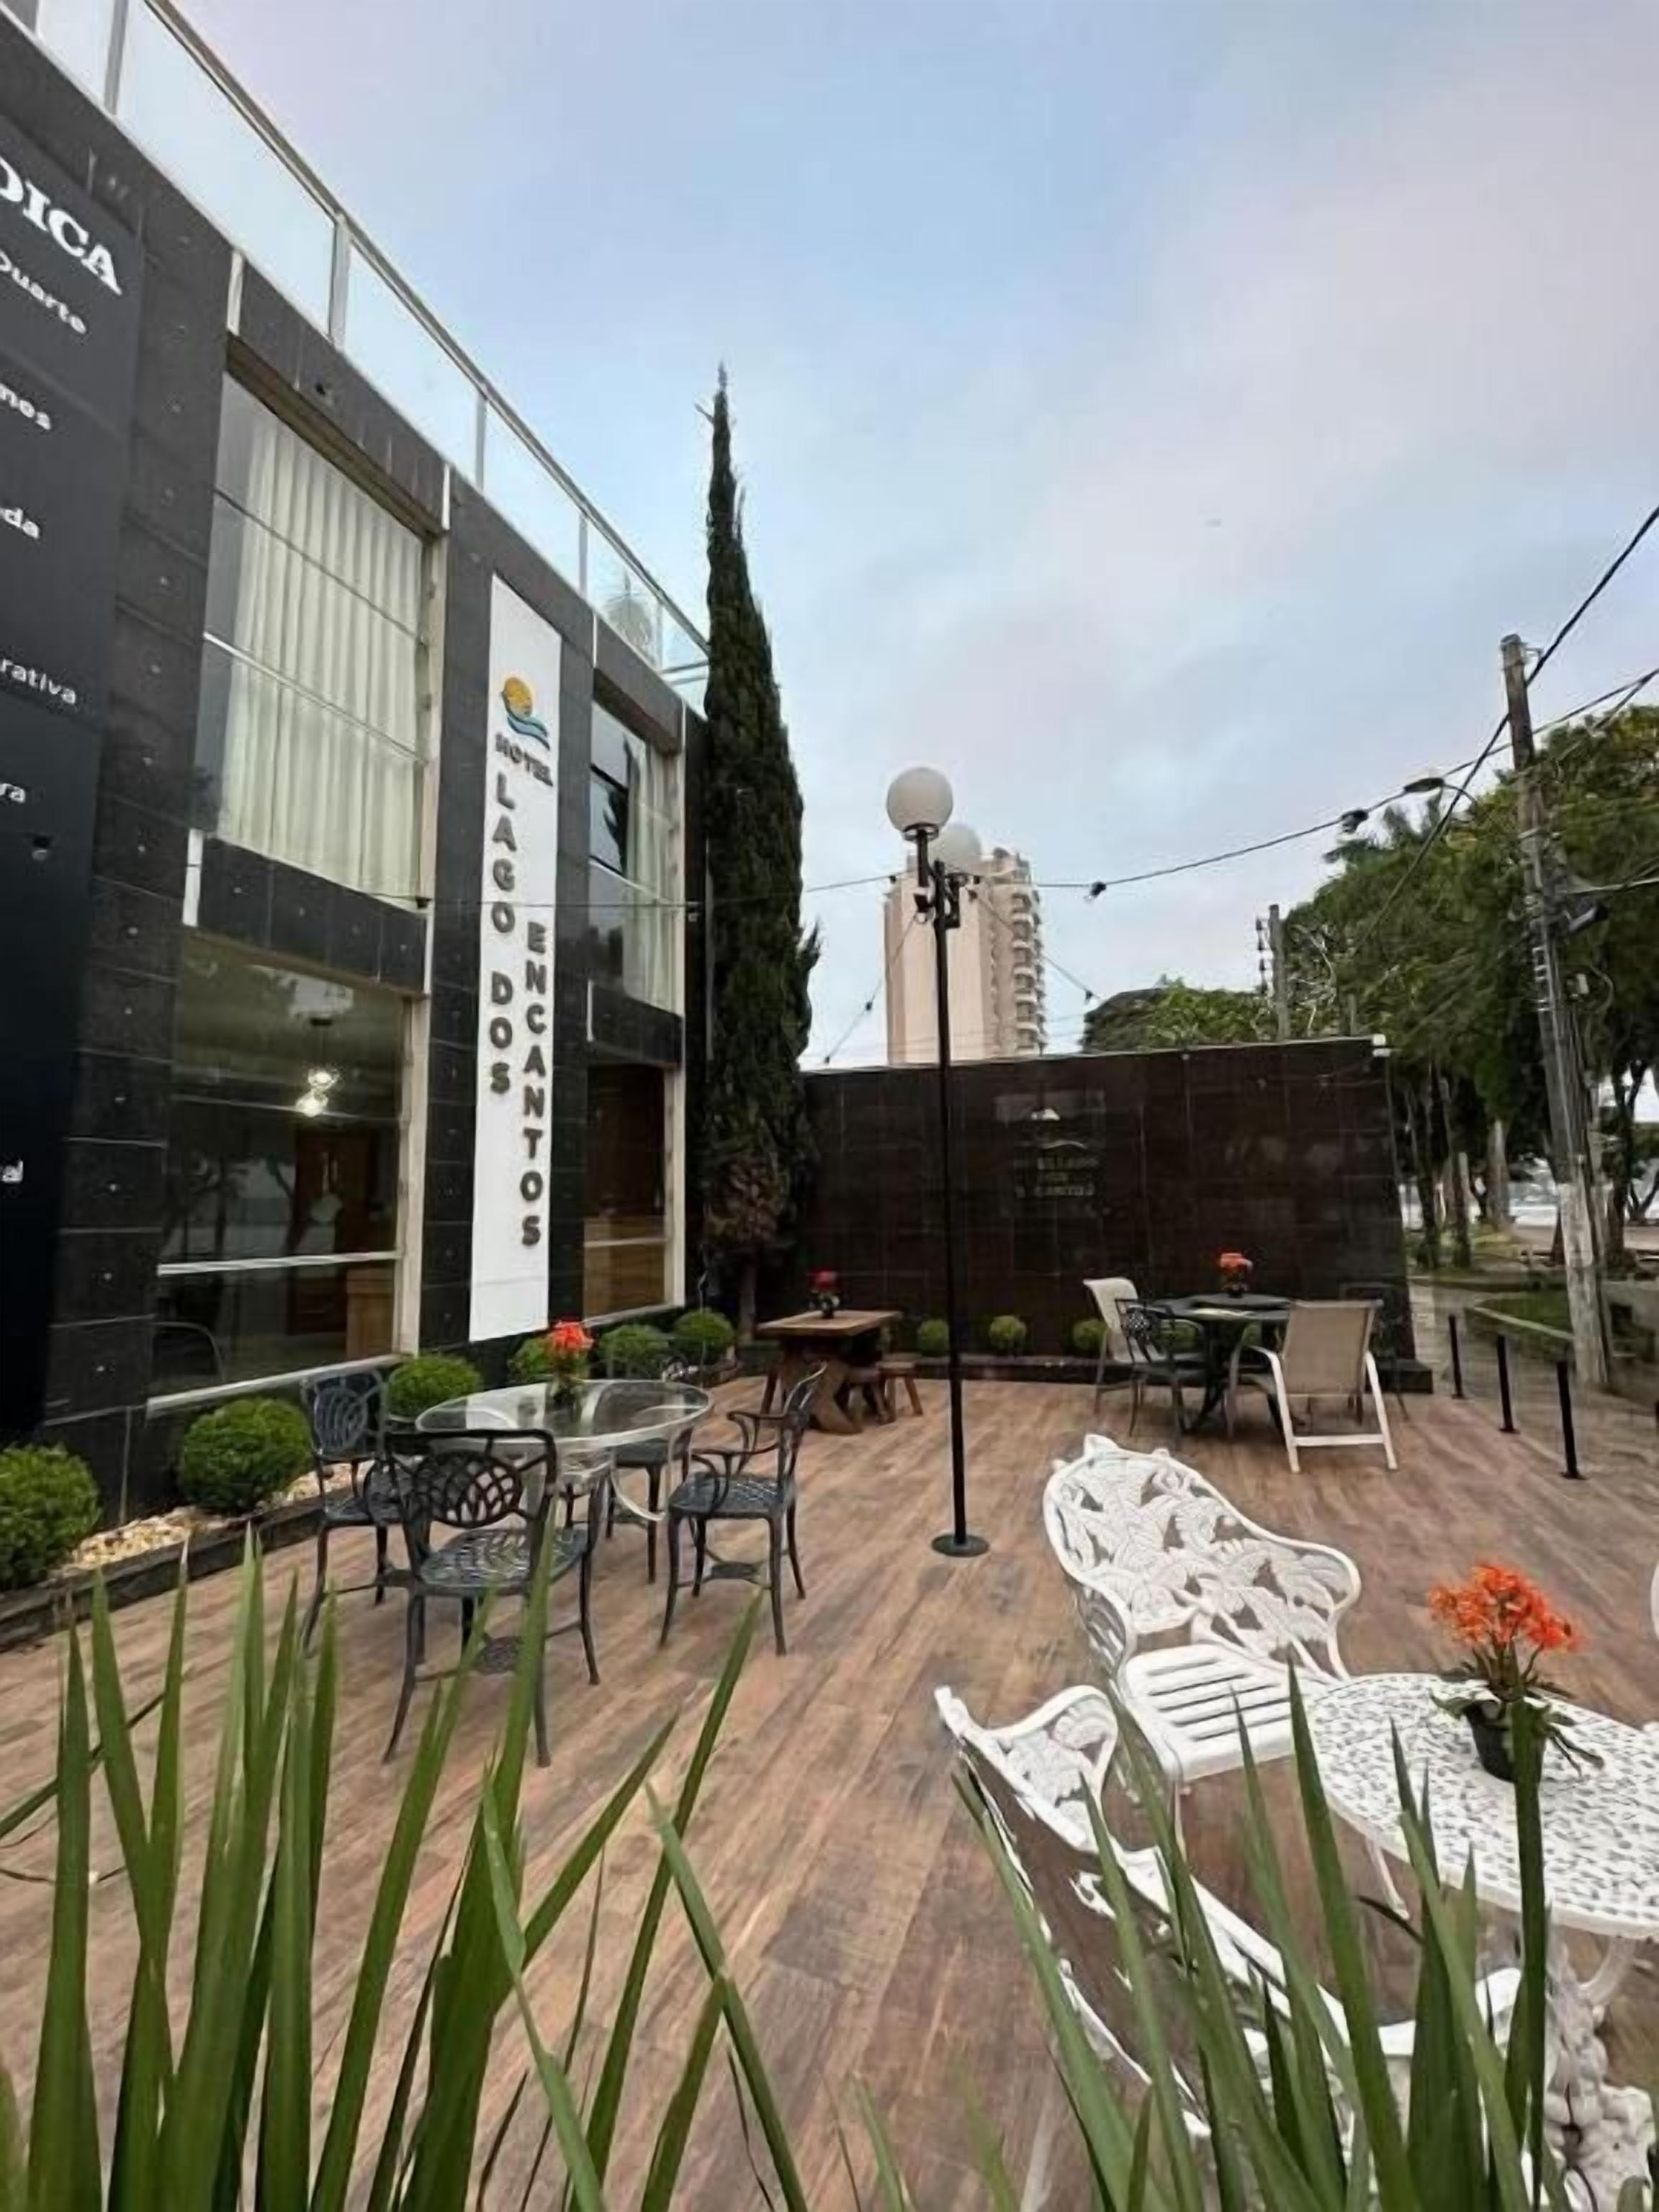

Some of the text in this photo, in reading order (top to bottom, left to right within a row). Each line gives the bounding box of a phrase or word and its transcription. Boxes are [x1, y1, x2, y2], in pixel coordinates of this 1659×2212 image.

[0, 507, 40, 539] da
[495, 733, 554, 787] HOTEL
[490, 772, 517, 1094] LAGO DOS
[520, 921, 547, 1247] ENCANTOS
